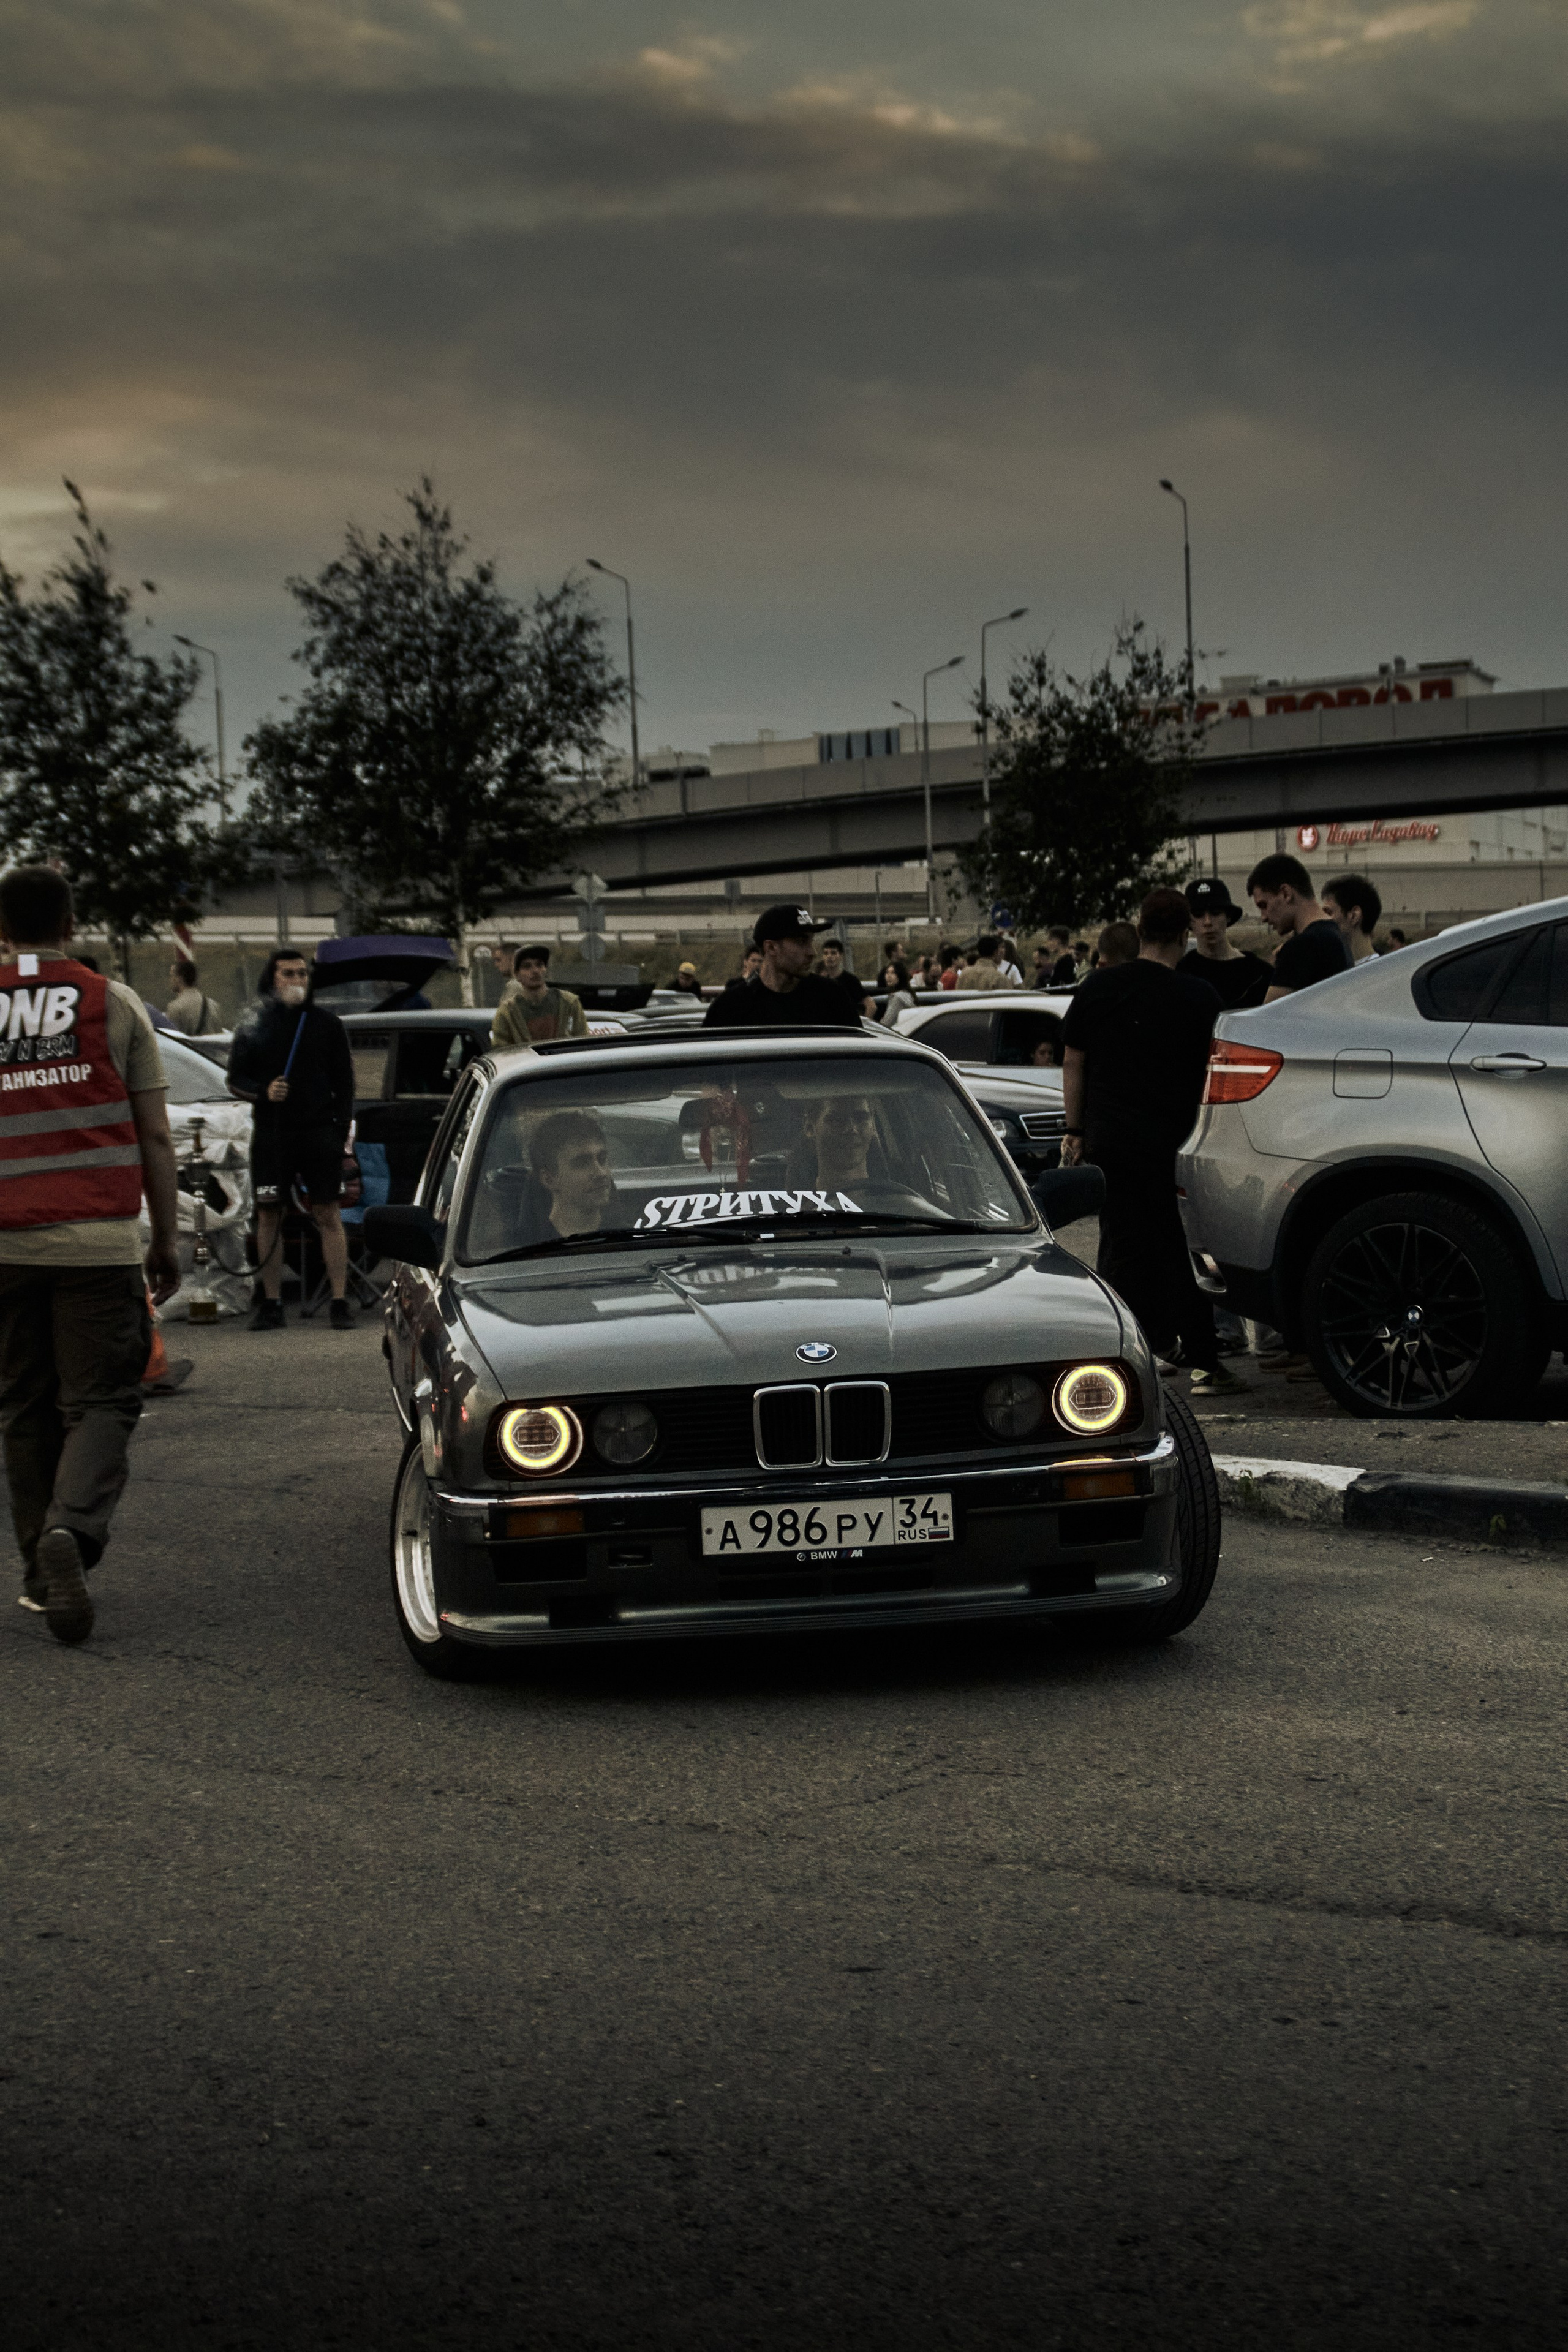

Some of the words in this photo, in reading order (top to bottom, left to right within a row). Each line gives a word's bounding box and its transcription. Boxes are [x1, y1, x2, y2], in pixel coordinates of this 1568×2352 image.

[0, 1063, 92, 1091] АНИЗАТОР
[899, 1497, 939, 1528] 34
[898, 1529, 927, 1540] RUS
[810, 1551, 837, 1560] BMW
